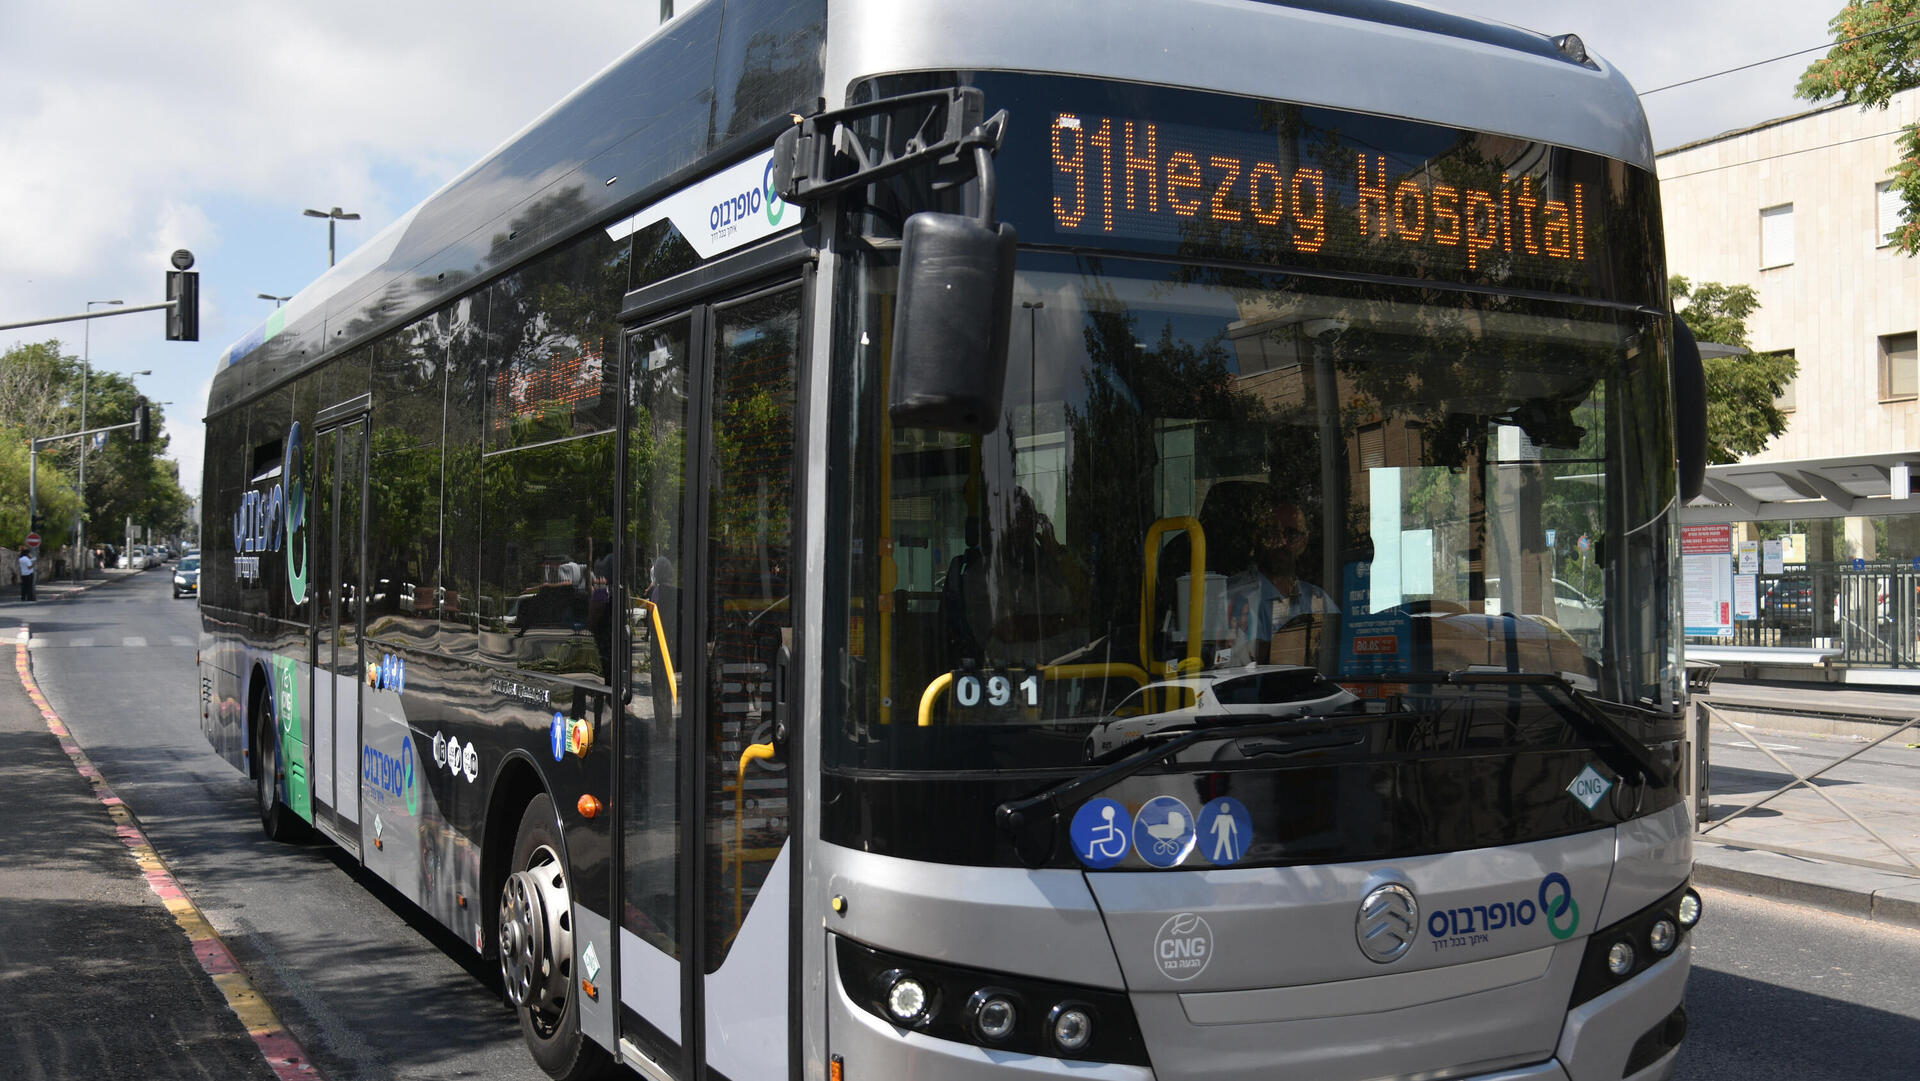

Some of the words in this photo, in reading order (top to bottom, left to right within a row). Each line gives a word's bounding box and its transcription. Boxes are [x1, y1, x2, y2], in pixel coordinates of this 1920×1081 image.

[1124, 121, 1325, 252] Hezog
[1357, 153, 1585, 270] Hospital
[710, 187, 761, 231] סופרבוס
[956, 674, 1039, 707] 091
[363, 743, 403, 798] סופרבוס
[1576, 778, 1602, 796] CNG
[1427, 899, 1537, 938] סופרבוס
[1160, 937, 1206, 959] CNG
[1431, 939, 1448, 952] דרך
[1449, 936, 1467, 947] בכל
[1468, 934, 1488, 946] איתך
[1179, 958, 1201, 968] הנעה
